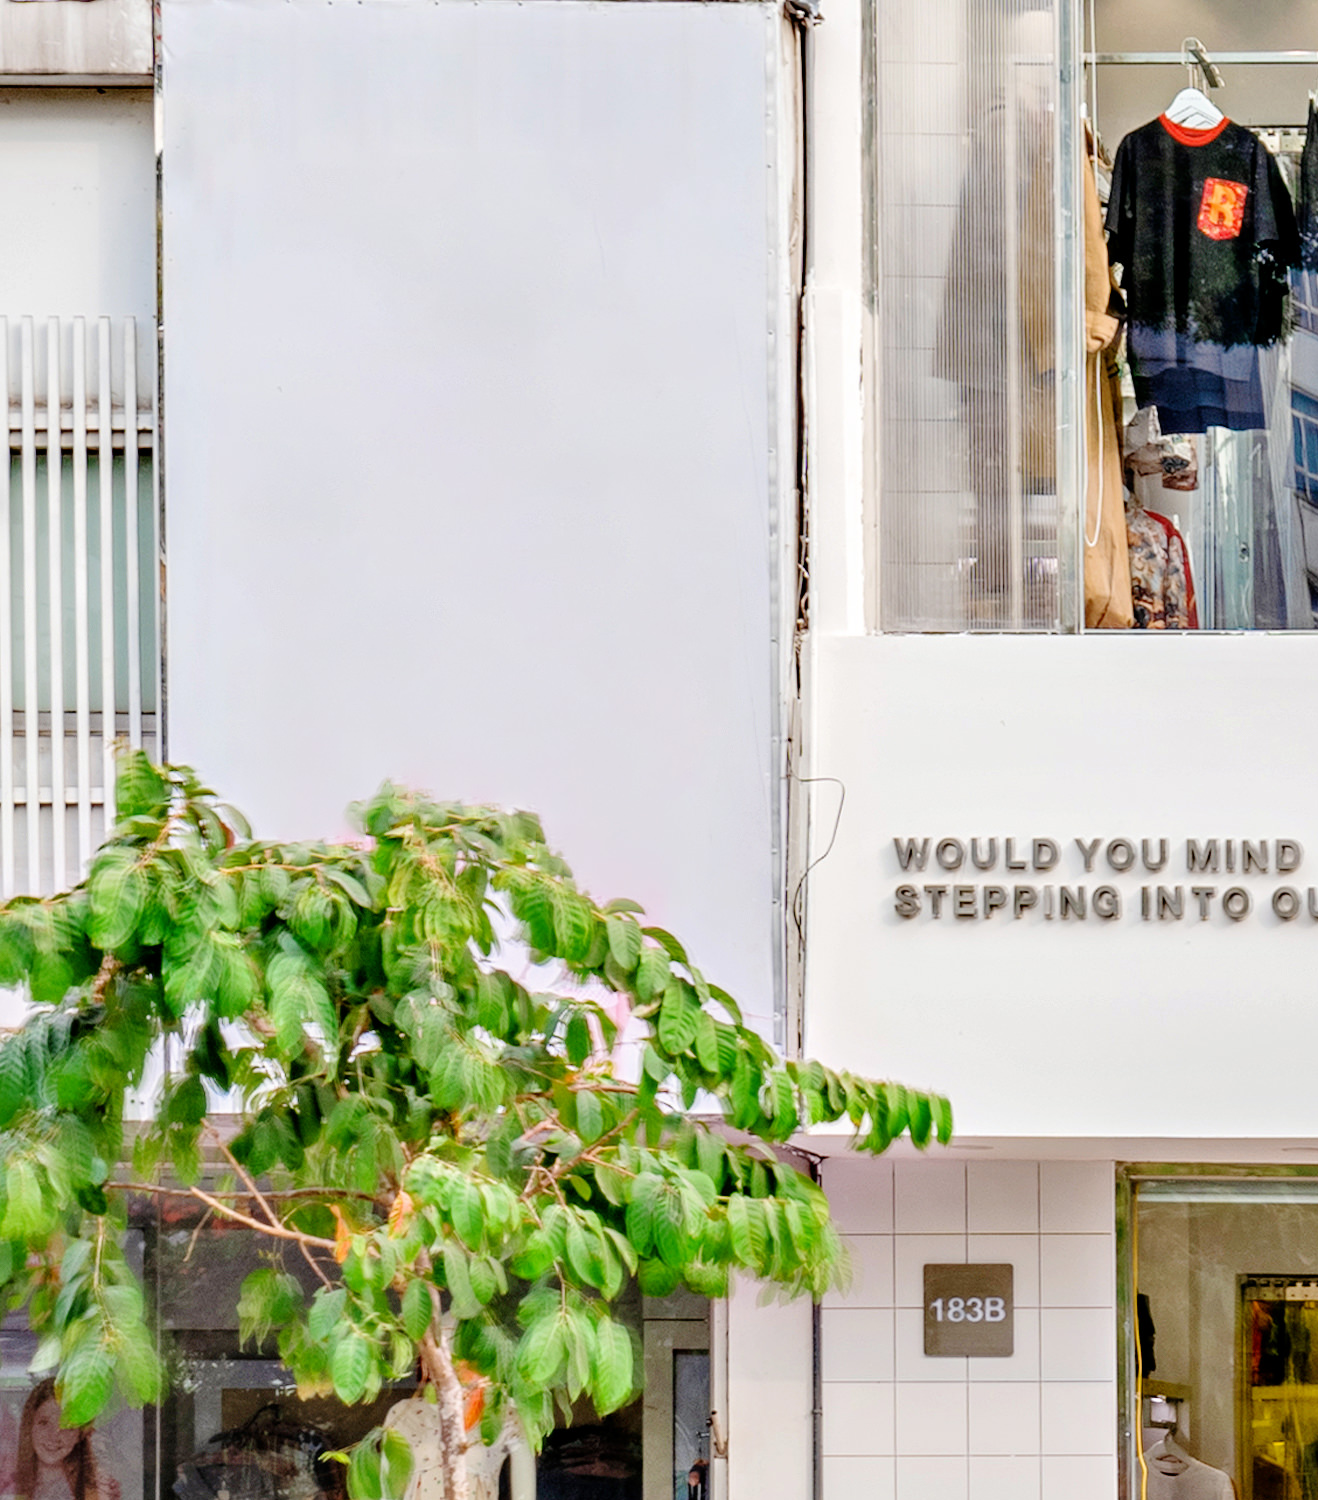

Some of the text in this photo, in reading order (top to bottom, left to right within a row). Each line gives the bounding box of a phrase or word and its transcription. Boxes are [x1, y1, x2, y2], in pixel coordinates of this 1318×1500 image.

[892, 836, 1305, 873] WOULD YOU MIND
[893, 883, 1121, 920] STEPPING
[929, 1297, 1006, 1323] 183B
